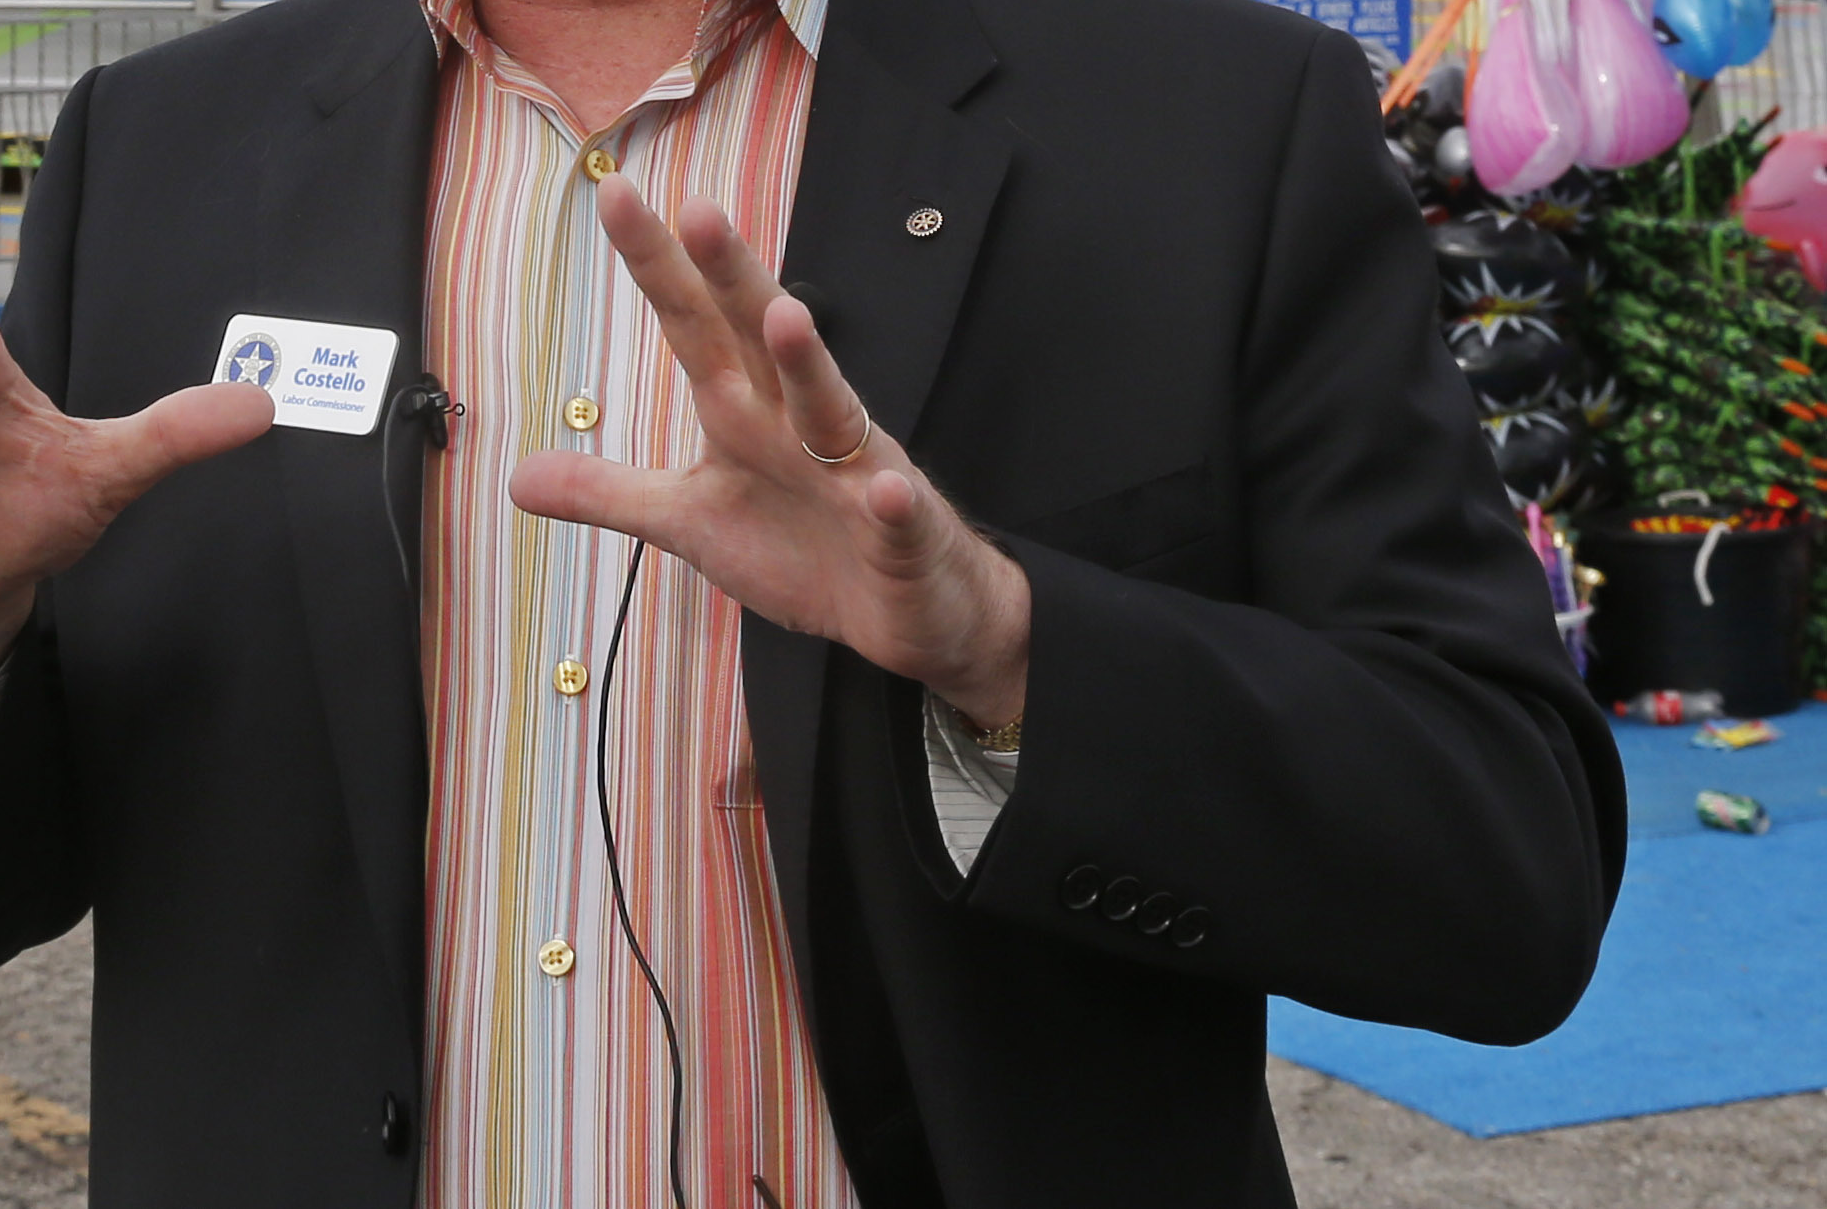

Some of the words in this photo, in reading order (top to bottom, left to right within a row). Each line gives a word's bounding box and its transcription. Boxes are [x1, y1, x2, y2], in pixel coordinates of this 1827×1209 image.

[311, 347, 360, 369] Mark
[293, 368, 366, 392] Costello
[282, 394, 306, 406] Labor
[307, 396, 366, 413] Commissioner
